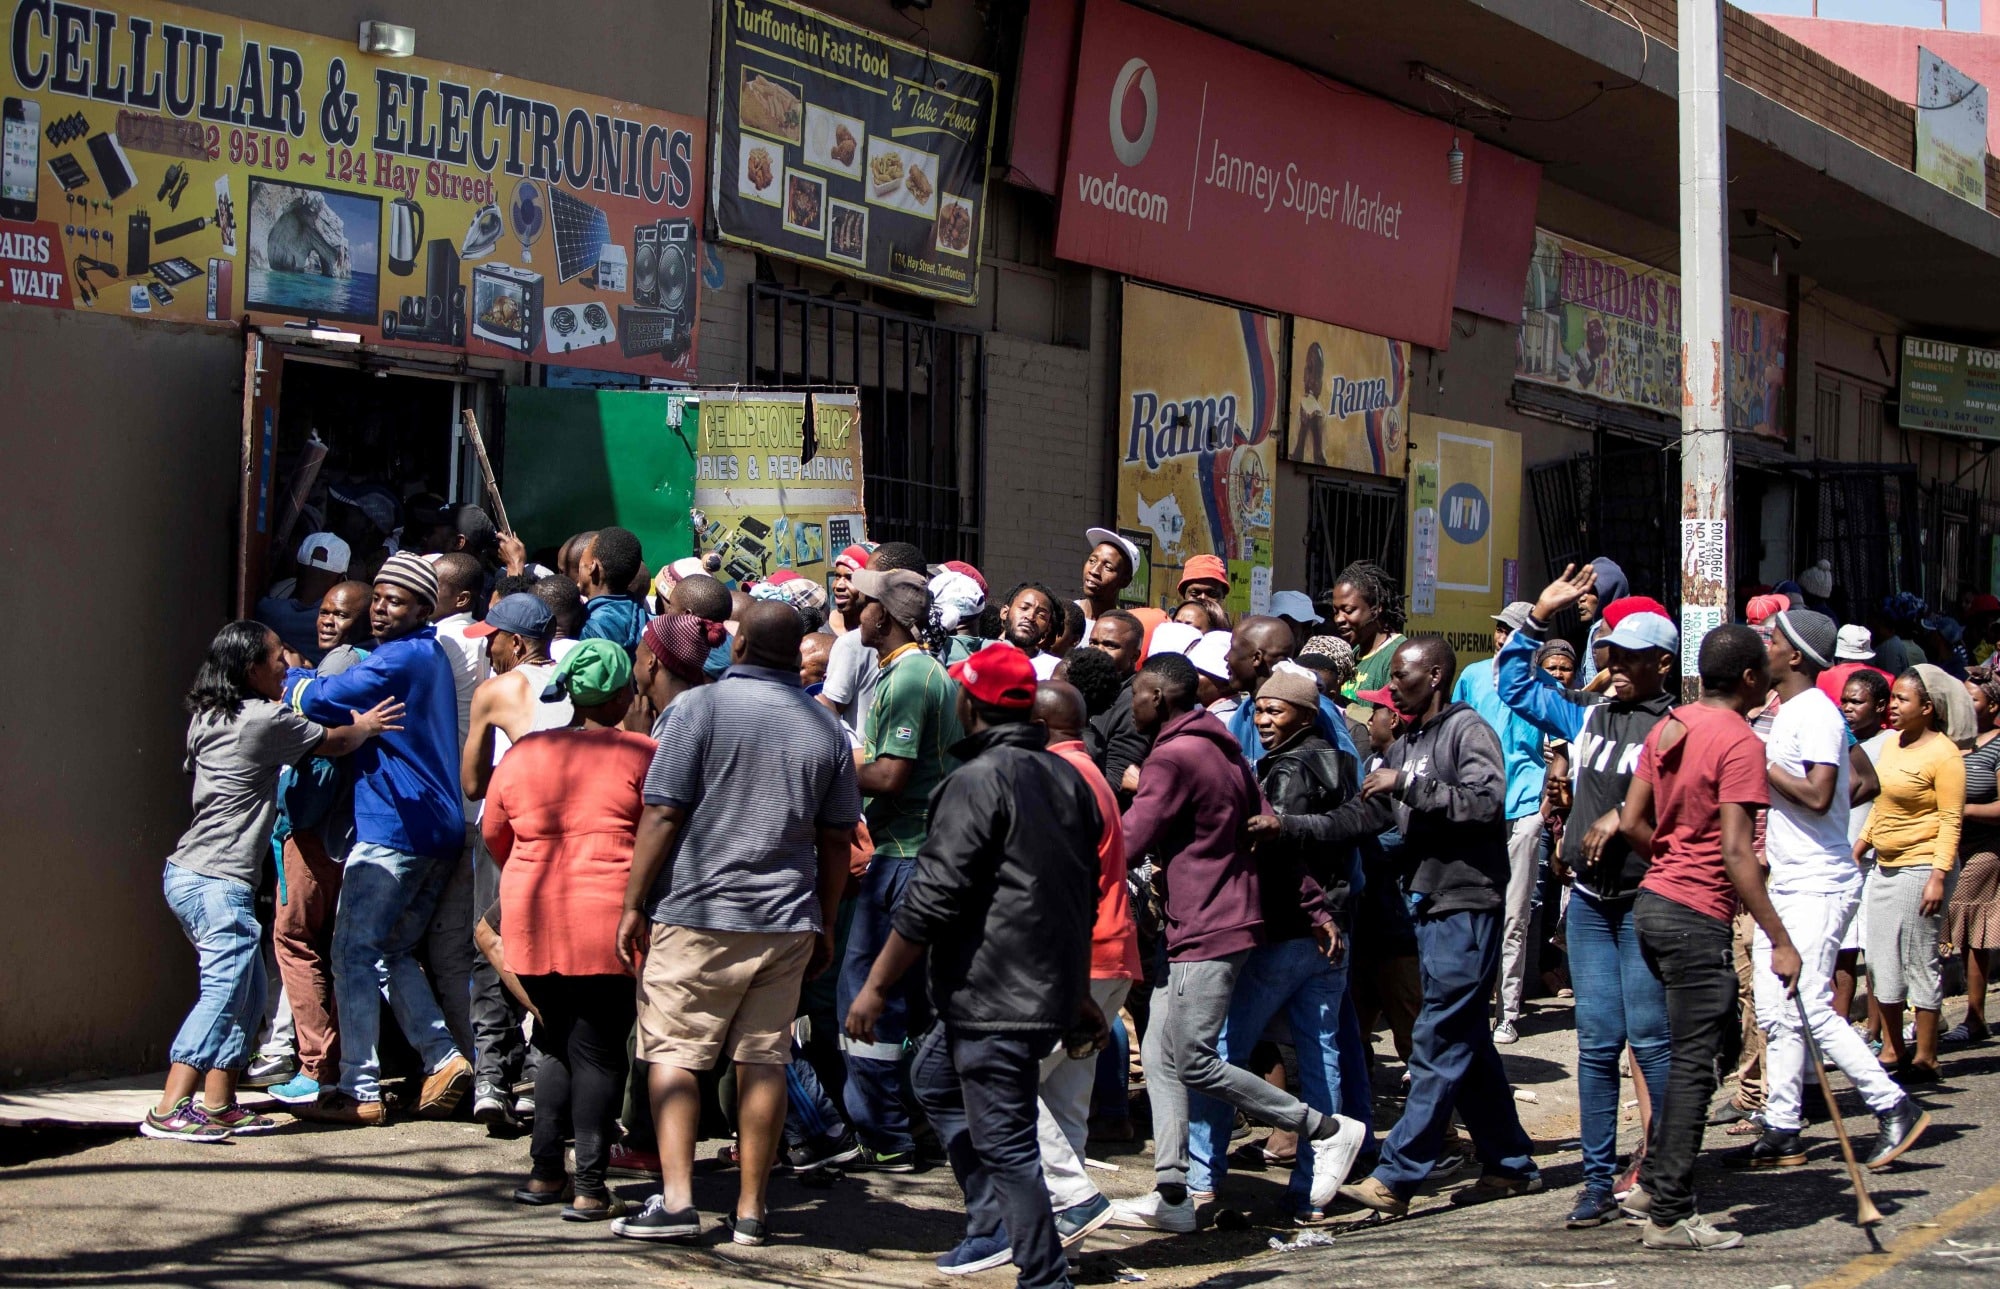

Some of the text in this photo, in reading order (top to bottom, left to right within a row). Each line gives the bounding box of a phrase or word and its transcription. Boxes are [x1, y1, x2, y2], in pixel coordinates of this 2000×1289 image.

[734, 1, 889, 80] Turffontein Fast Food
[11, 0, 693, 208] CELLULAR & ELECTRONICS
[891, 84, 978, 141] & Take Away
[228, 127, 291, 171] 9519
[325, 147, 367, 184] 124
[374, 153, 420, 200] Hay
[425, 161, 494, 205] Street
[1078, 172, 1169, 224] vodacom
[1204, 138, 1402, 241] Janney Super Market
[0, 231, 50, 264] AIRS
[906, 255, 919, 273] Hay
[937, 263, 967, 281] Turffontein
[10, 268, 62, 300] WAIT
[1561, 249, 1660, 332] FARIDA'S
[1905, 339, 1959, 363] ELLISIF
[1329, 376, 1386, 420] Rama
[1965, 399, 1985, 409] BABY
[705, 404, 850, 451] CELLPHONE HOP
[1125, 391, 1237, 470] Rama
[747, 455, 761, 480] &
[768, 455, 854, 481] REPAIRING
[1449, 495, 1482, 531] MTN
[1447, 632, 1495, 653] SUPERMA
